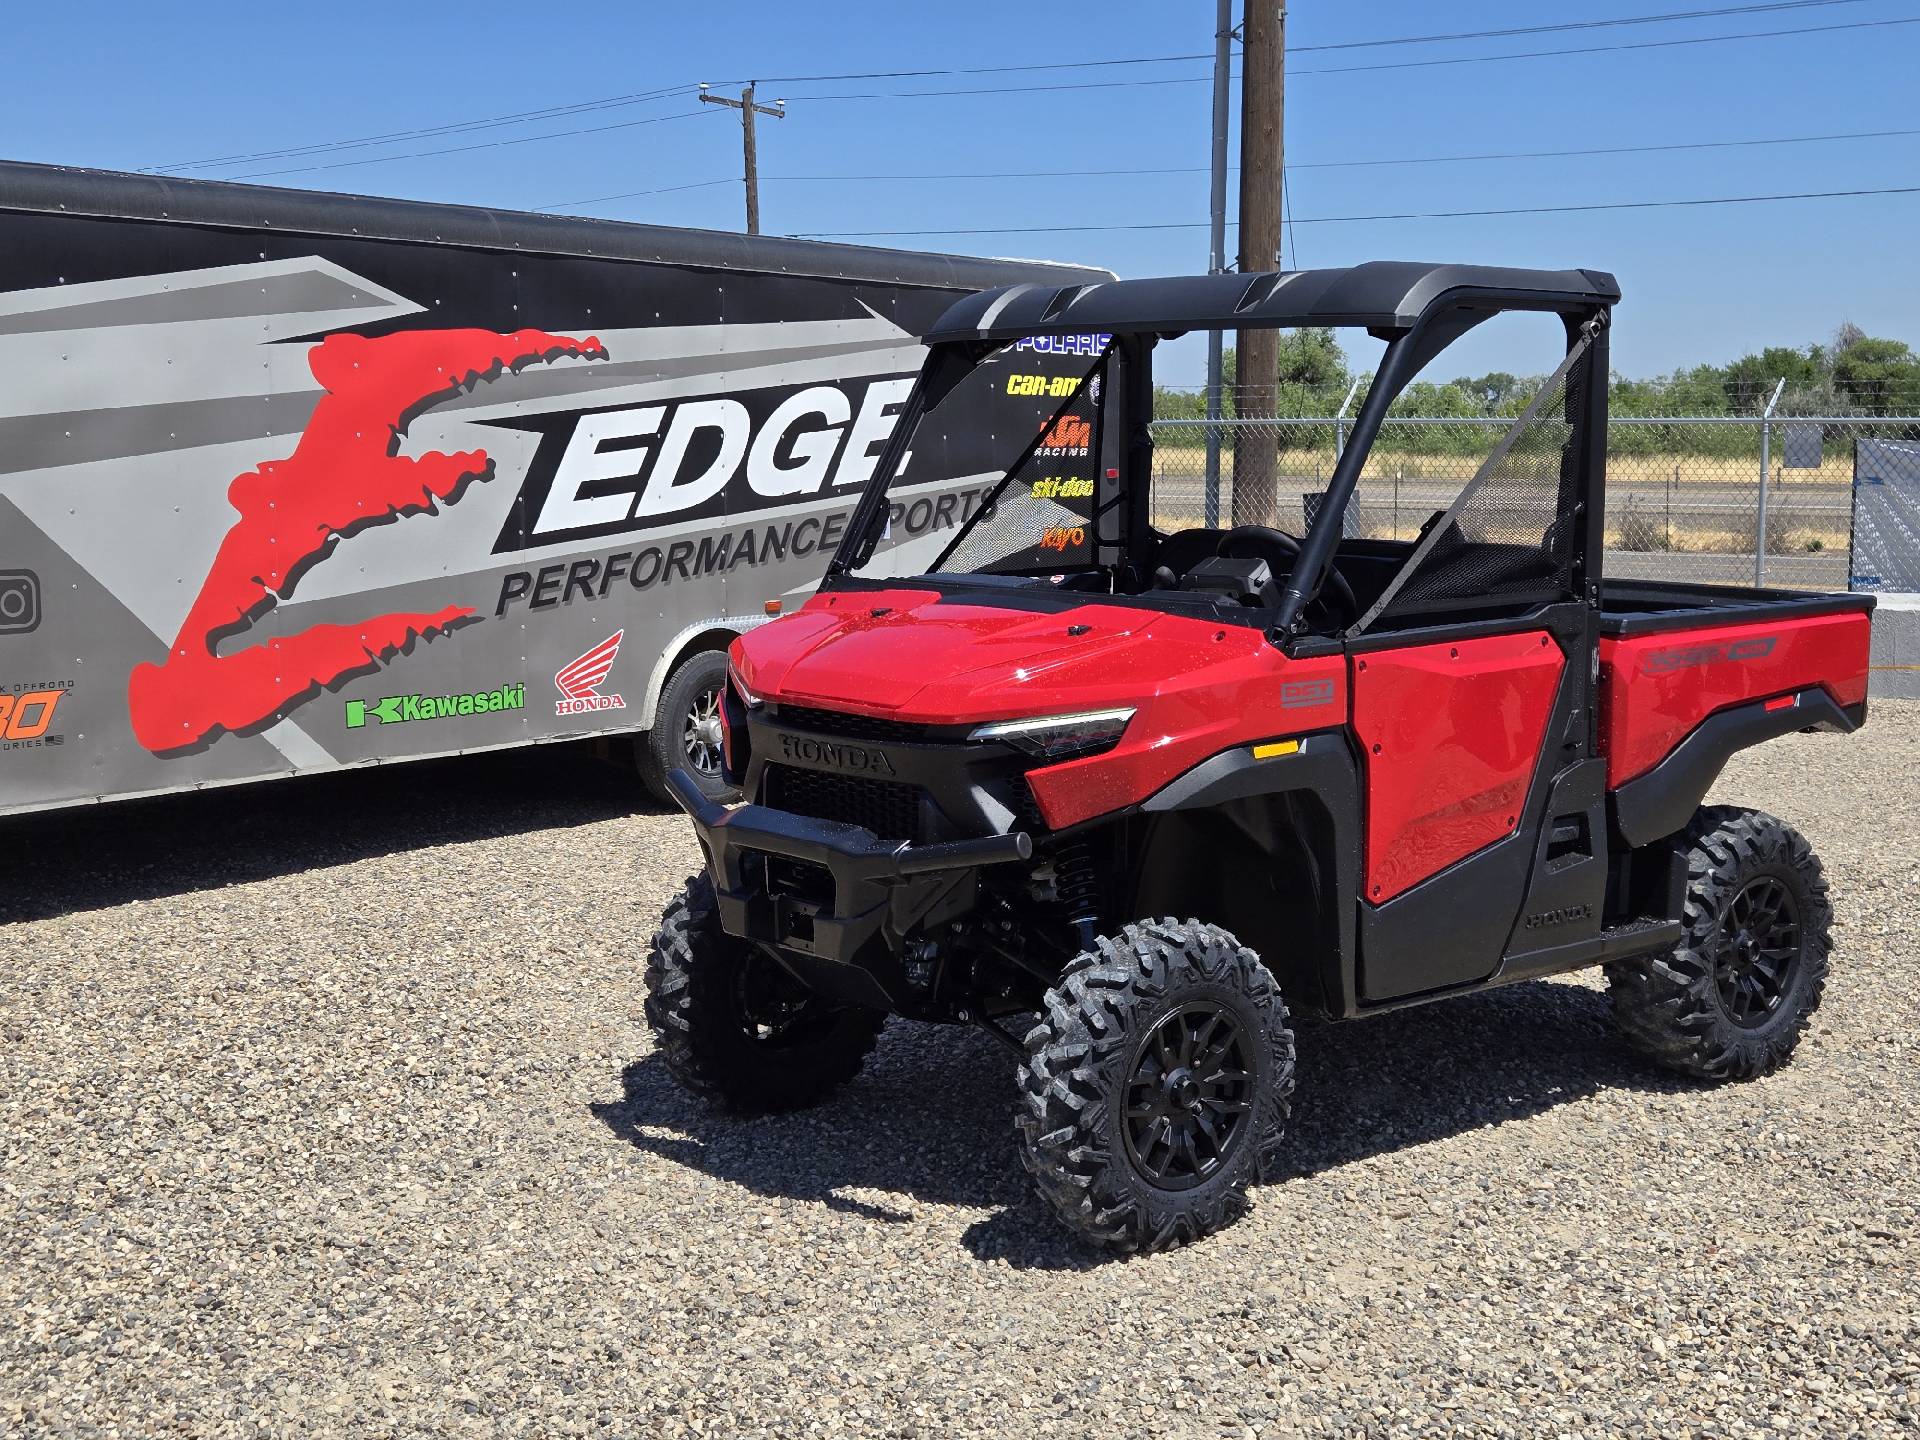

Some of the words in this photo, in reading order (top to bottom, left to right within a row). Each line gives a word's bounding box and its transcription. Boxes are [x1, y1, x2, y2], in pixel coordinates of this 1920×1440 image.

[532, 377, 919, 535] EDGE
[1033, 447, 1088, 456] RACING
[494, 512, 846, 617] PERFORMANCE
[14, 680, 74, 692] OFFROAD
[403, 682, 525, 721] Kawasaki
[556, 694, 626, 715] HONDA
[778, 733, 896, 776] HONDA
[1526, 903, 1593, 929] HONDA
